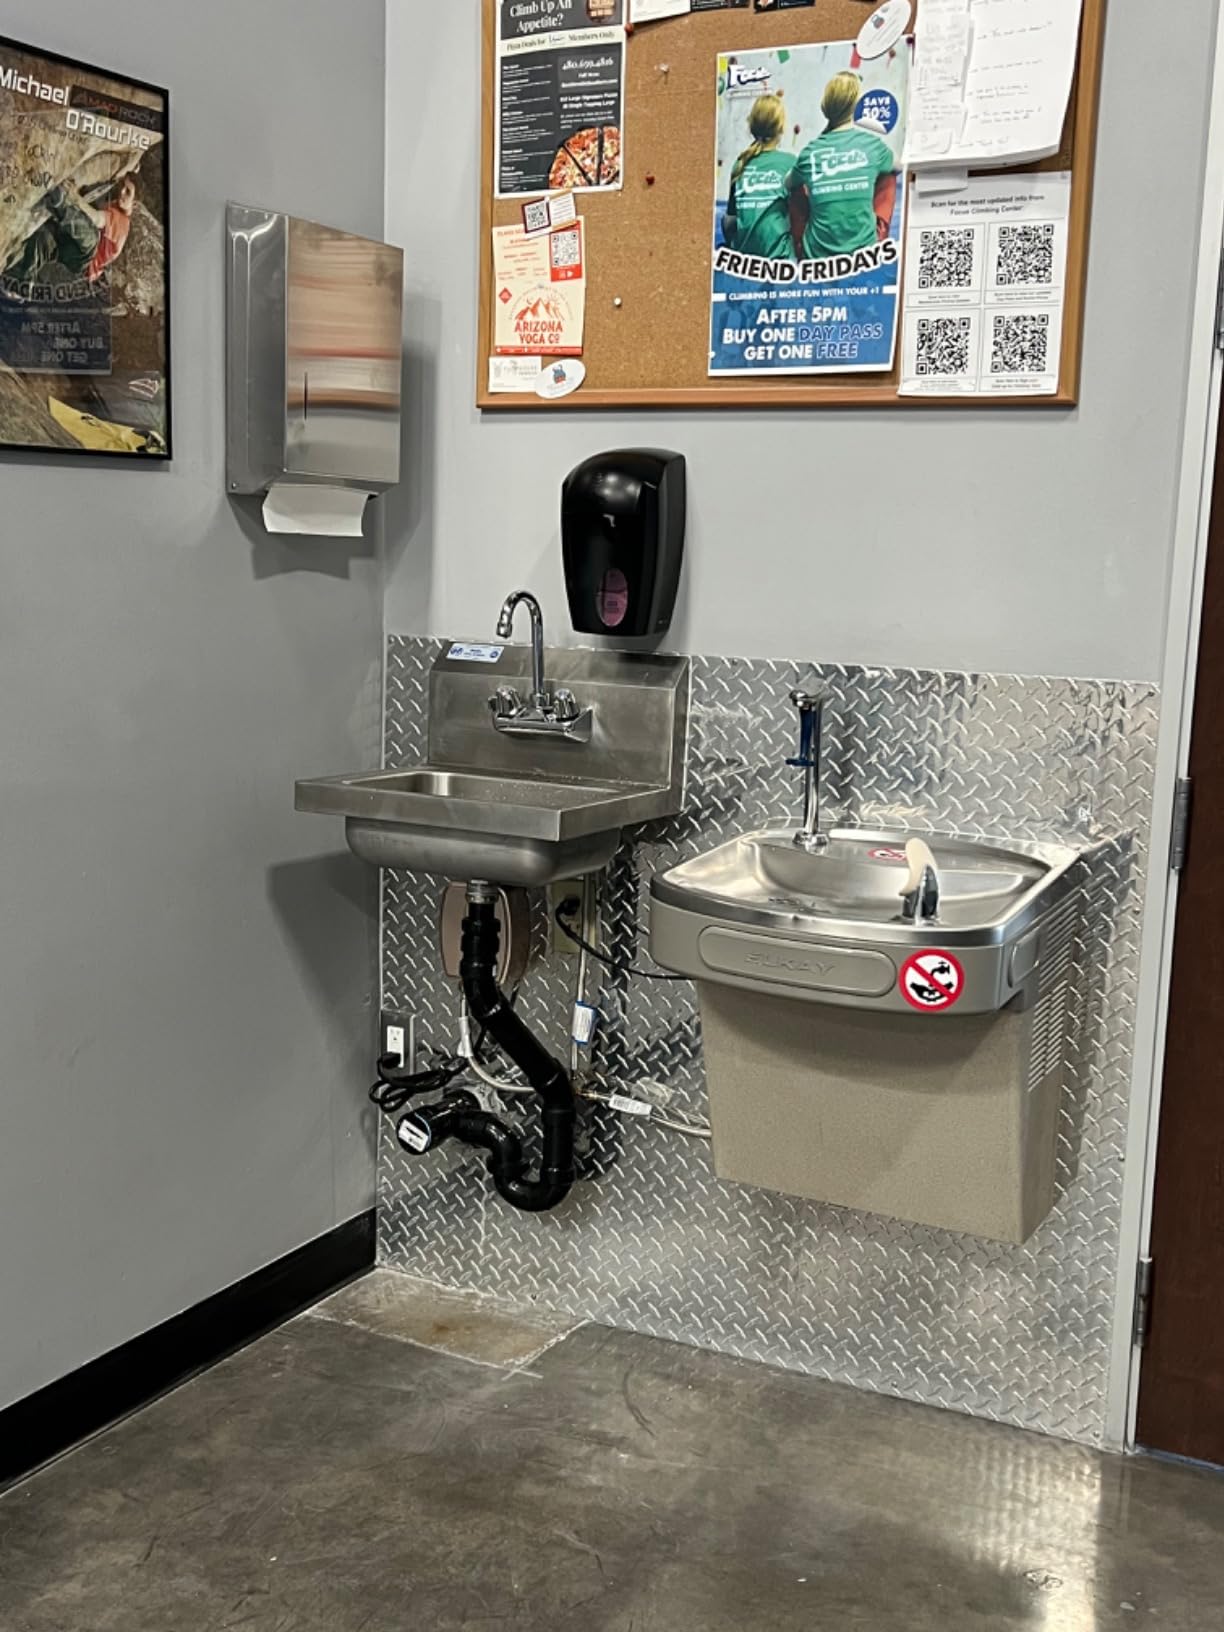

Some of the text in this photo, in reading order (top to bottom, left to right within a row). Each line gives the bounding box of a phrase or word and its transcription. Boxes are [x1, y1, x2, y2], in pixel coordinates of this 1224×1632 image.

[510, 1, 539, 17] Climb
[517, 12, 564, 33] Appetite?
[568, 33, 598, 42] Members
[599, 31, 616, 40] Only
[0, 66, 70, 106] Michael
[864, 96, 890, 106] SAVE
[863, 106, 891, 119] 50%
[66, 109, 151, 150] O'Rourke
[844, 181, 869, 190] CENTER
[987, 196, 1014, 206] updated
[970, 207, 1000, 215] Climbing
[715, 240, 897, 281] FRIEND FRIDAYS
[729, 286, 880, 300] CLIMBING IS MORE FUN WITH YOUR +1
[756, 306, 847, 325] AFTER 5PM
[514, 321, 563, 333] ARIZONA
[723, 324, 883, 344] BUY ONE DAY PASS
[519, 333, 545, 344] YOGA
[744, 342, 859, 360] GET ONE FREE
